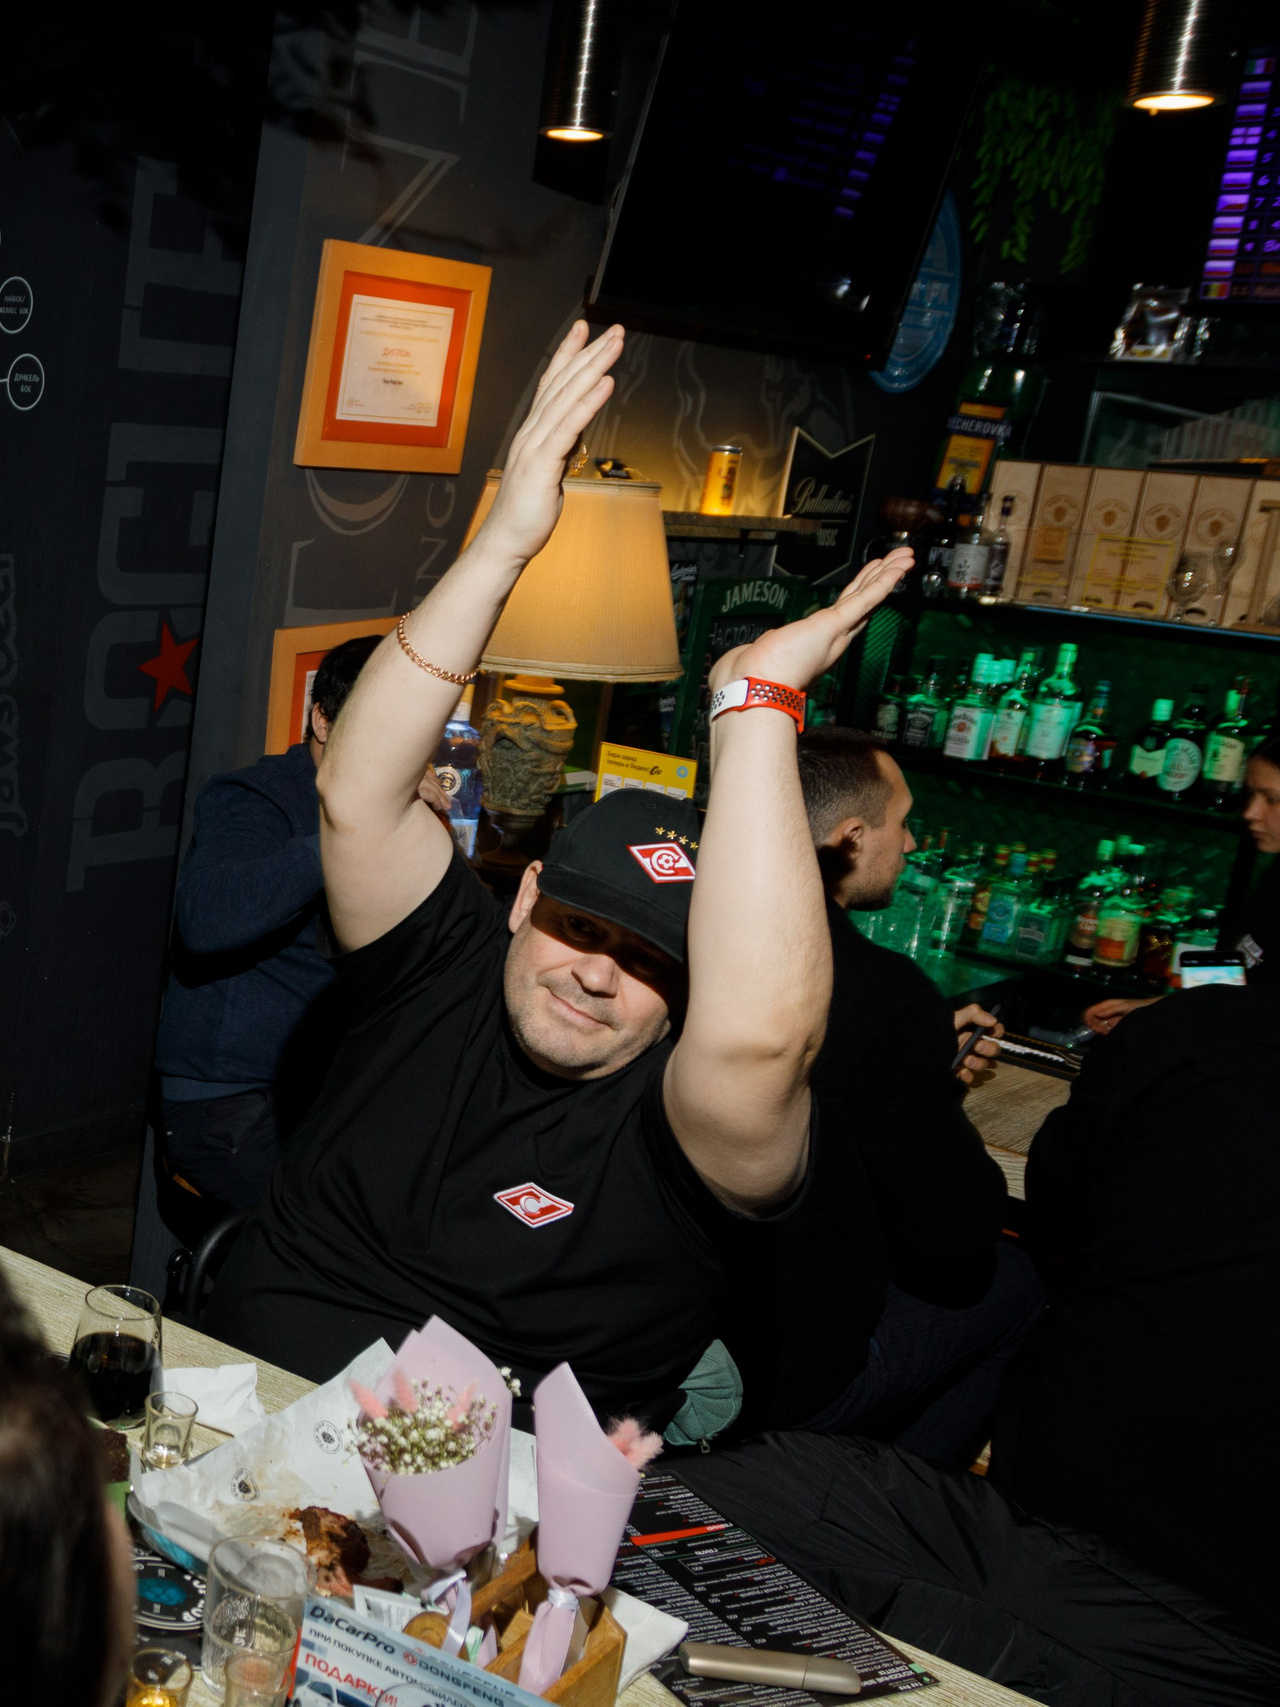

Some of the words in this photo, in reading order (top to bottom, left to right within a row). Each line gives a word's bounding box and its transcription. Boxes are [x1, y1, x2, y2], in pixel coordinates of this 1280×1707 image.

[14, 373, 40, 382] ДУНКЕЛЬ
[20, 385, 32, 393] БОК
[948, 416, 1012, 437] ECHEROVKA
[722, 580, 790, 613] JAMESON
[607, 751, 621, 759] Бери
[649, 765, 662, 775] Go
[309, 1605, 396, 1655] DaCarPro
[309, 1628, 331, 1644] ПРИ
[333, 1637, 384, 1669] ПОКУПКЕ
[874, 1664, 912, 1675] САЛАТЫ
[419, 1661, 505, 1707] DONGFENG
